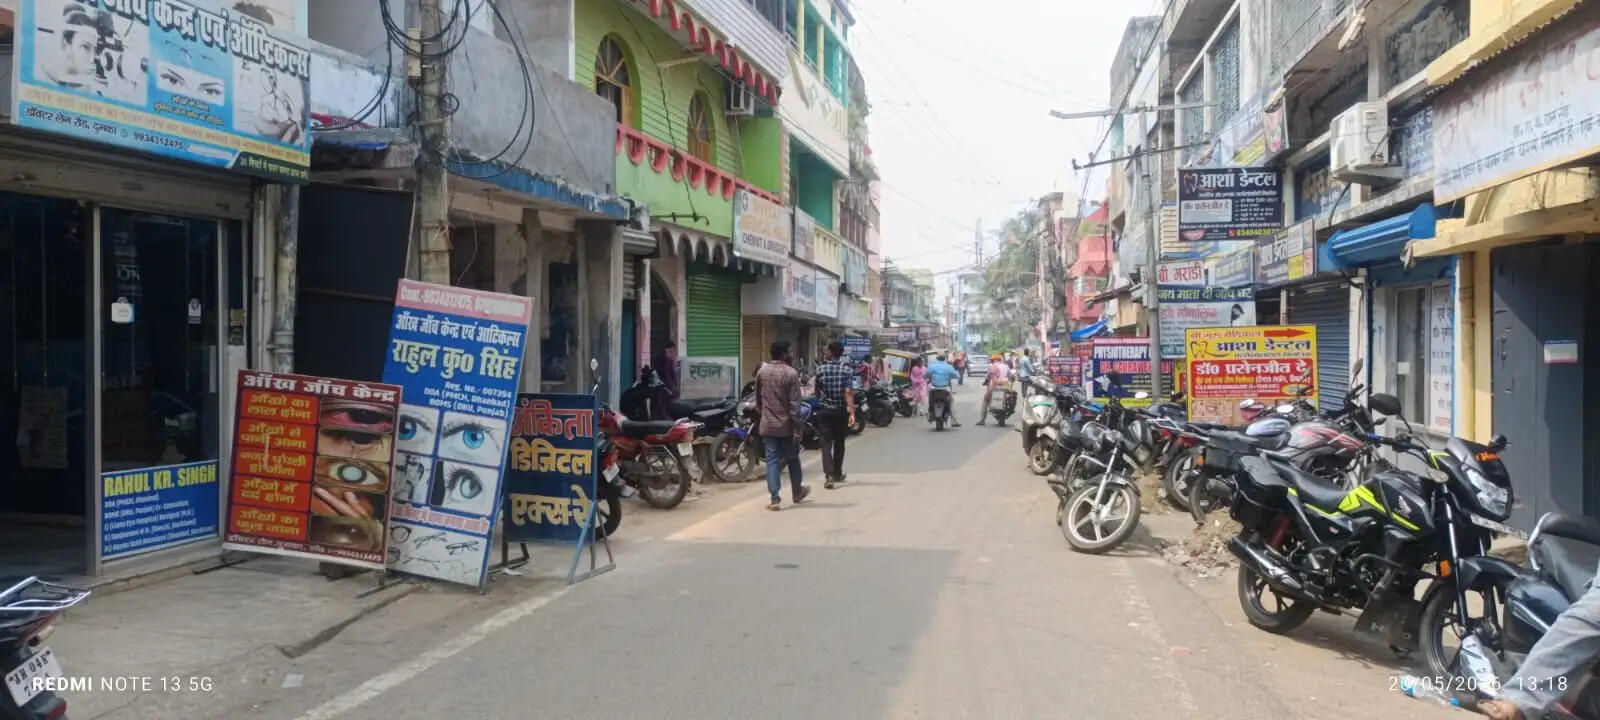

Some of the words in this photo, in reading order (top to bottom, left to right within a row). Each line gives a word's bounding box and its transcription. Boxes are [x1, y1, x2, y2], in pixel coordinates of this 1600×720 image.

[200, 8, 230, 50] एवं
[92, 122, 117, 135] दुमका
[1239, 168, 1276, 186] डेन्टल
[1094, 345, 1148, 359] PHYSIOTHERAPY
[392, 338, 440, 373] राहुल
[480, 346, 519, 380] सिंह
[352, 383, 397, 402] केन्द्र
[292, 398, 309, 408] का
[248, 406, 277, 416] लाल
[281, 406, 311, 418] होना
[289, 427, 301, 437] से
[274, 438, 306, 448] आना
[510, 437, 592, 476] डिजिटल
[104, 473, 149, 497] RAHUL
[154, 470, 175, 489] KR.
[178, 464, 216, 487] SINGH
[283, 481, 298, 492] में
[265, 490, 295, 503] होना
[281, 515, 298, 525] का
